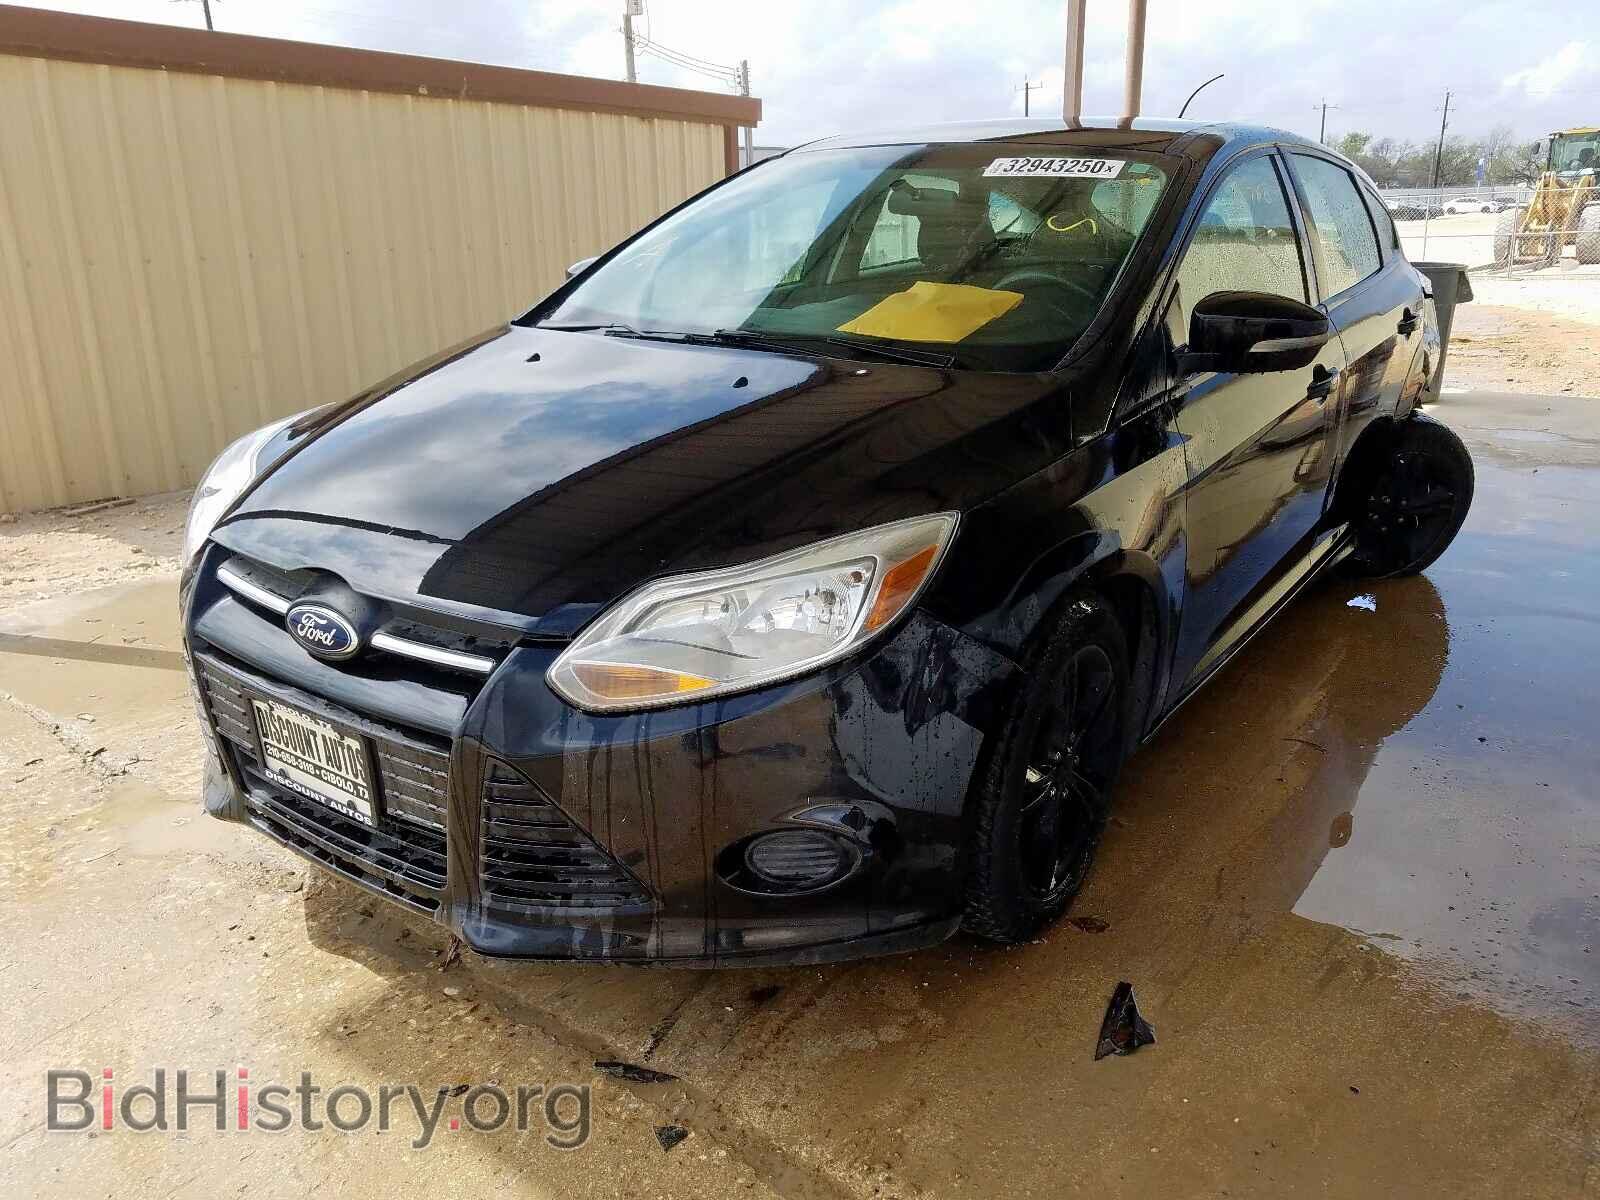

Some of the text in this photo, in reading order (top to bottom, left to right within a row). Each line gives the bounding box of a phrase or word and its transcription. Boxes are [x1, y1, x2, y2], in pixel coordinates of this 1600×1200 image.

[298, 613, 337, 646] Ford
[255, 705, 366, 782] DISCOUNT AUTOS
[265, 769, 373, 826] DISCOUNT AUTOS
[321, 769, 357, 796] CIBOLO,
